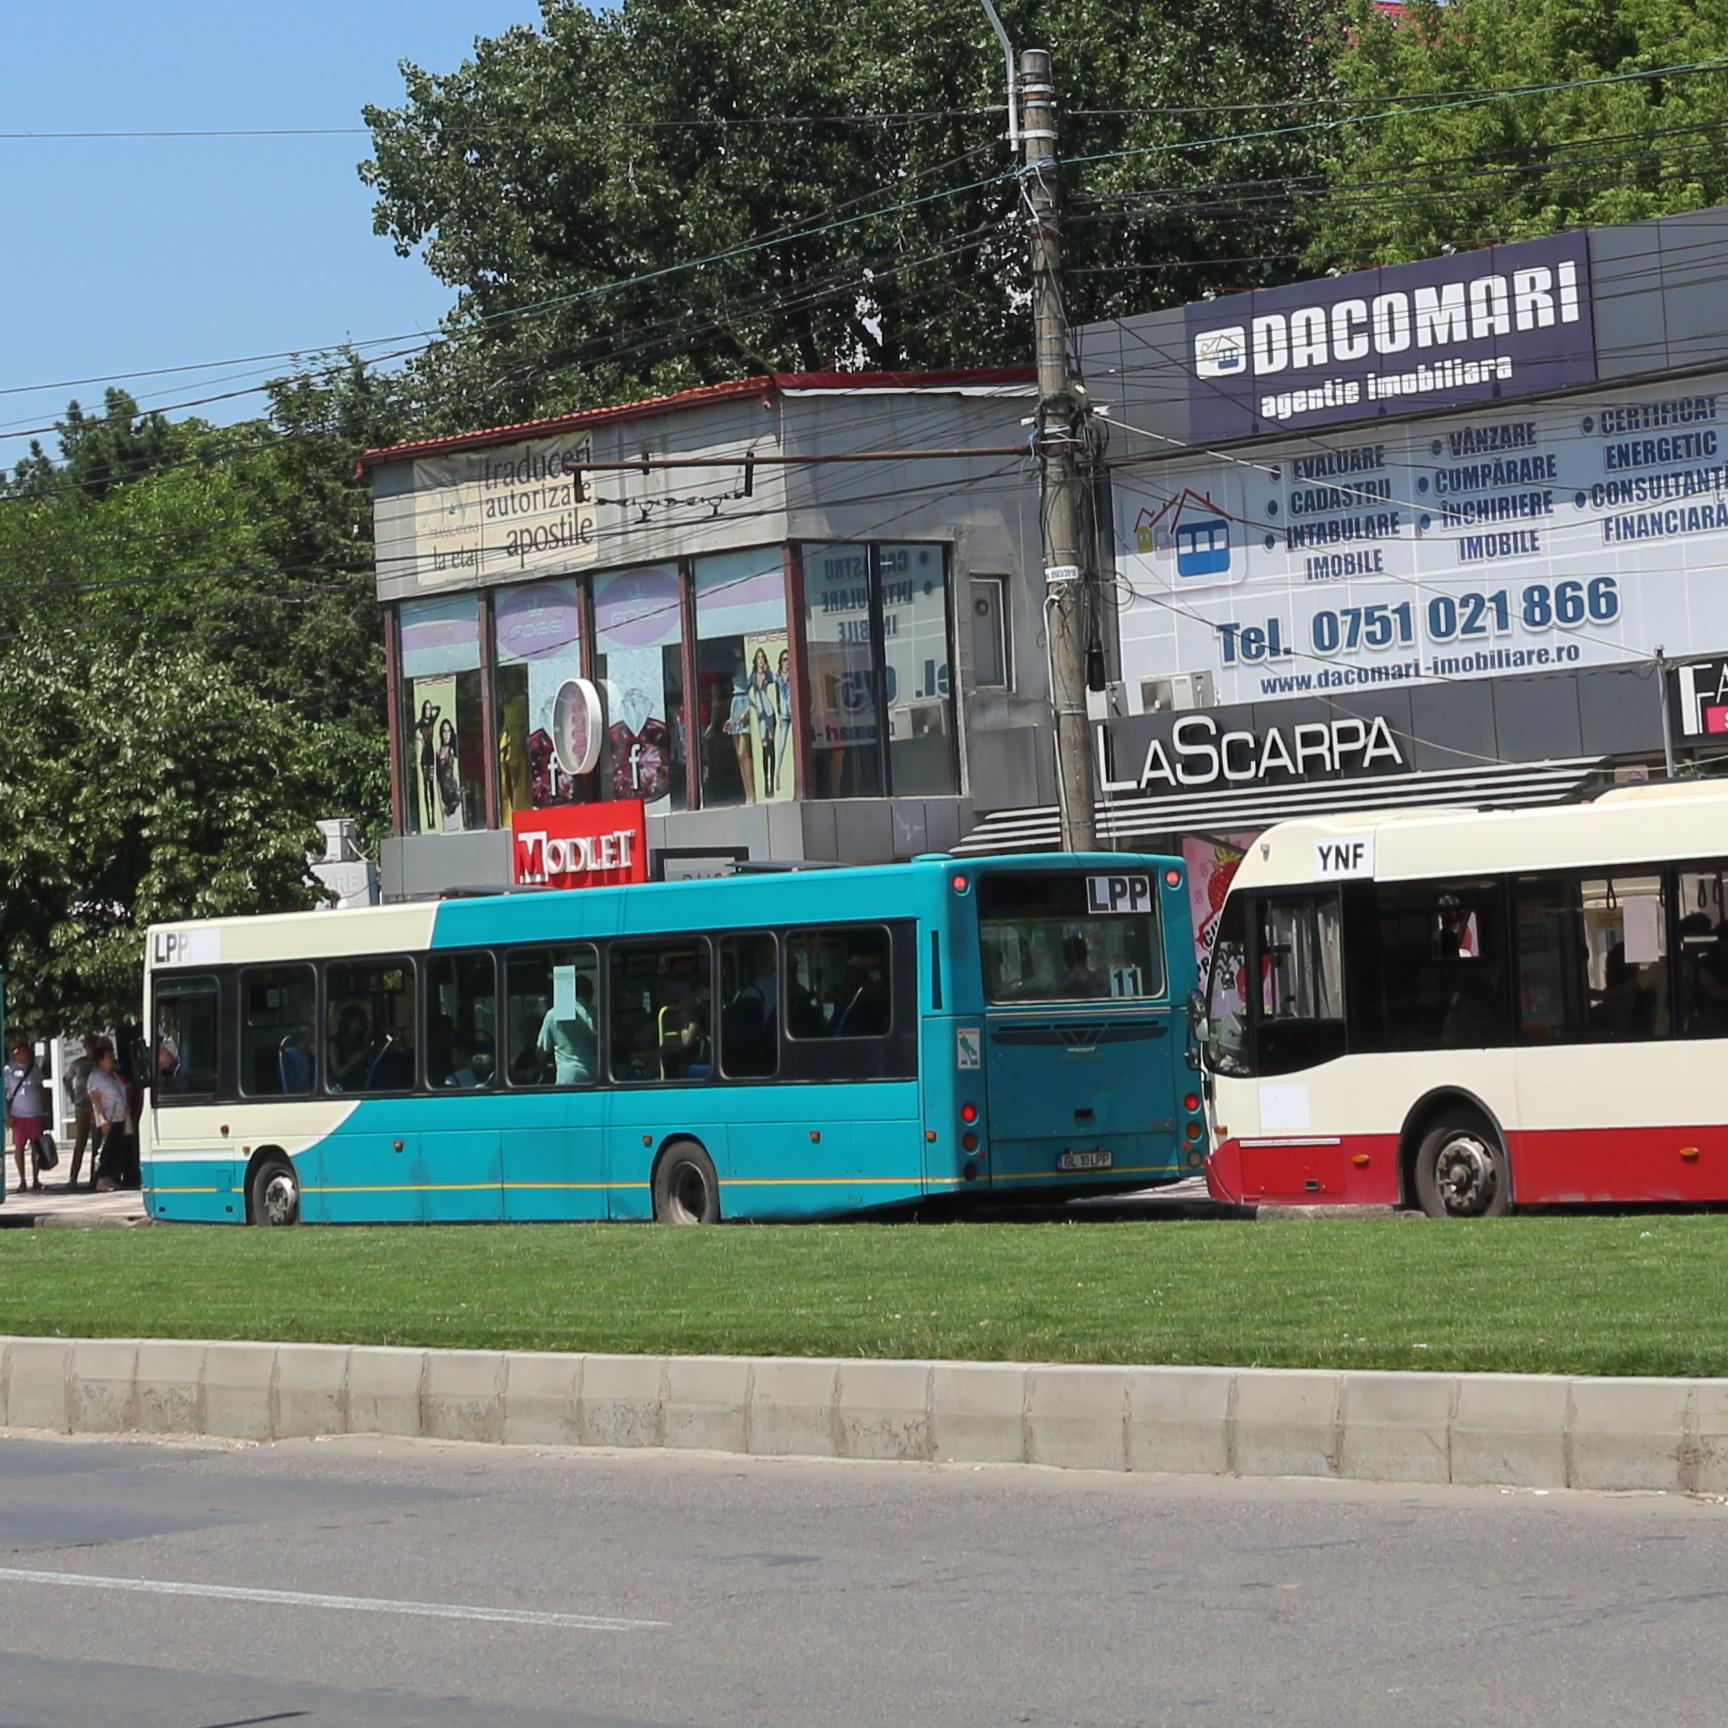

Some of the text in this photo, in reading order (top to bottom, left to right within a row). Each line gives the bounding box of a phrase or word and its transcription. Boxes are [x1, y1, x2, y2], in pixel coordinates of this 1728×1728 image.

[1252, 260, 1580, 376] DACOMARI
[1261, 355, 1513, 421] agentie imobiliara
[1601, 395, 1718, 435] CERTIFICAT
[484, 437, 591, 491] traduceri
[1292, 444, 1386, 481] EVALUARE
[1606, 430, 1718, 471] ENERGETIC
[1434, 453, 1558, 495] CUMPĂRARE
[486, 481, 592, 520] autorizae
[1290, 478, 1391, 516] CADASTRU
[505, 508, 594, 570] apostile
[1286, 511, 1400, 551] INTABULARE
[1458, 528, 1541, 562] IMOBILE
[432, 545, 446, 572] la
[1305, 548, 1384, 581] IMOBILE
[1215, 576, 1620, 666] Tel. 0751 021 866
[518, 828, 637, 884] MODLET
[1317, 843, 1365, 872] YNF
[1087, 876, 1148, 912] LPP
[154, 932, 188, 963] LPP
[1113, 968, 1141, 997] 11
[1091, 1152, 1110, 1167] LPP
